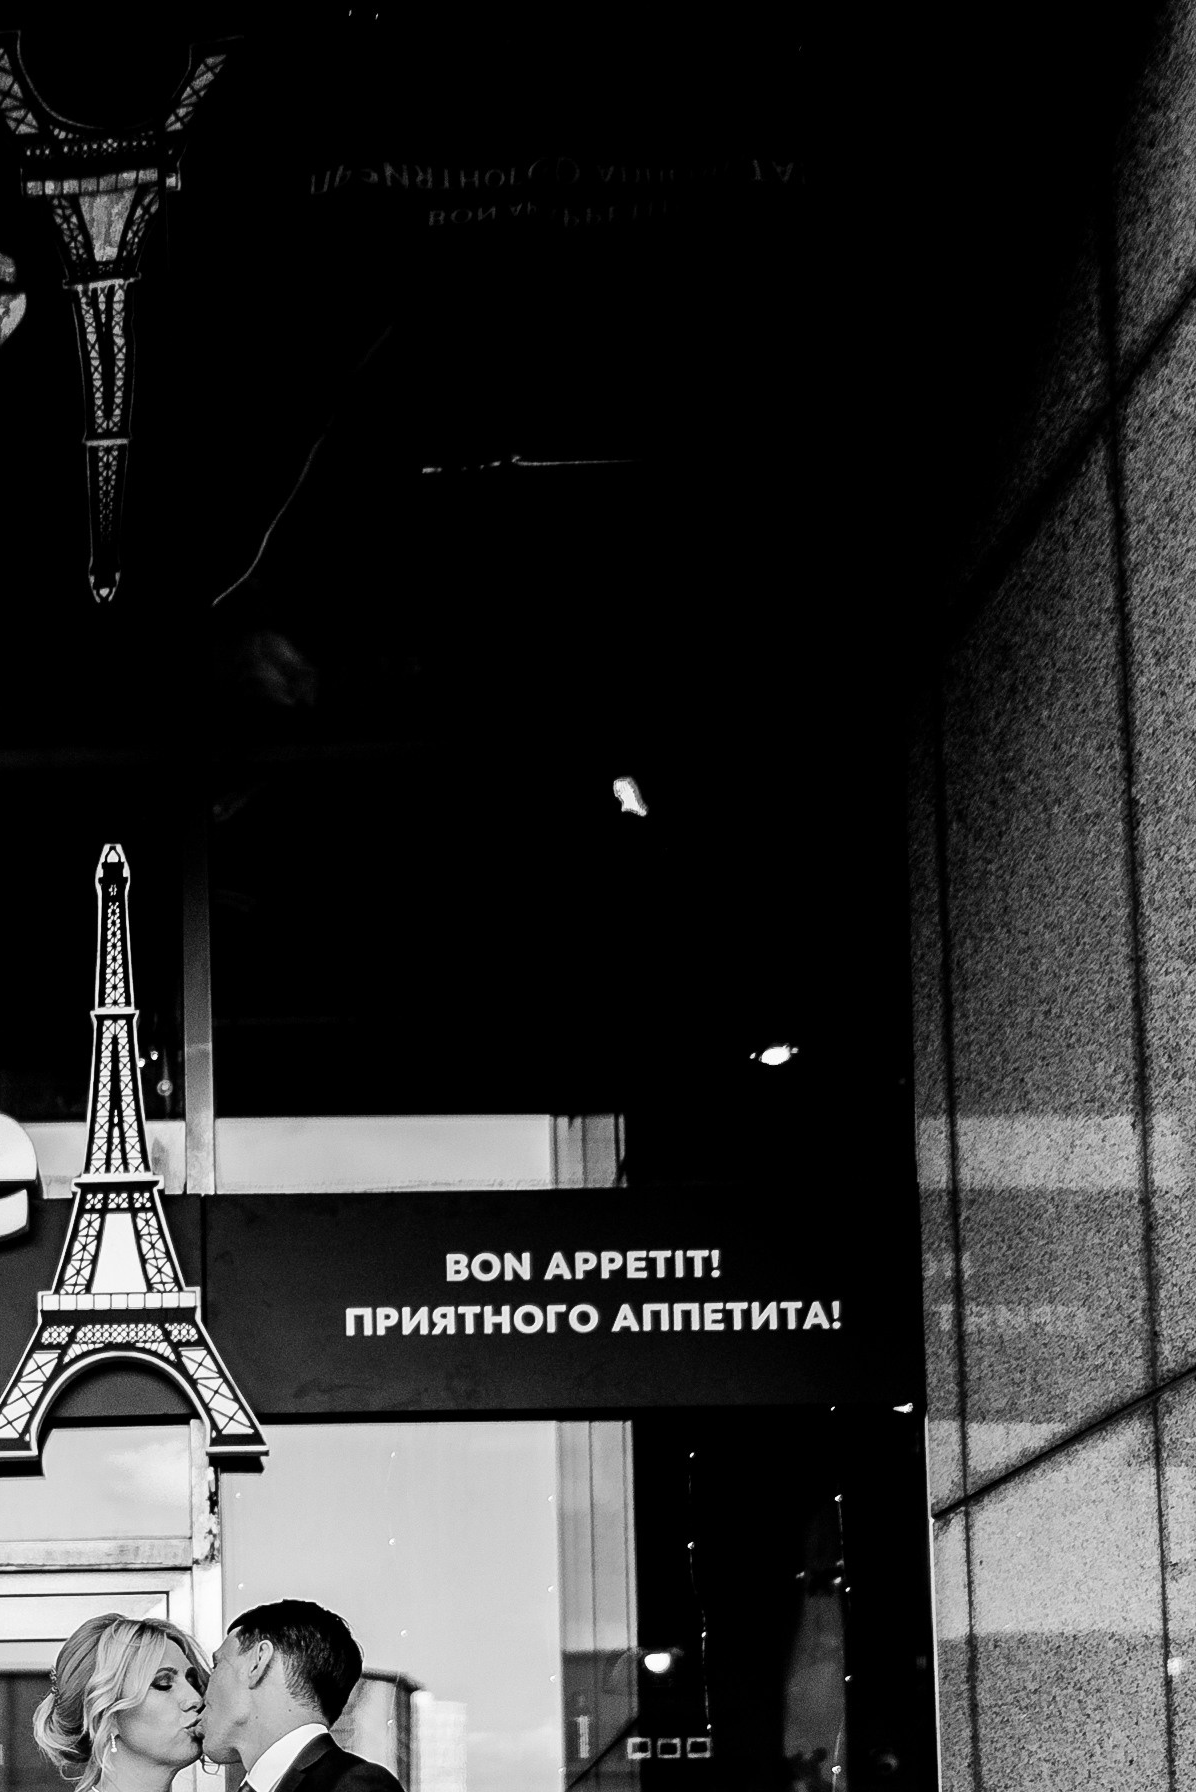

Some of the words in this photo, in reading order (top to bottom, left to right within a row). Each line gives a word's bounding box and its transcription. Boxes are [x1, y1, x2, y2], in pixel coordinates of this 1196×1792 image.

[445, 1252, 531, 1282] BON
[544, 1249, 721, 1280] APPETIT!
[345, 1303, 600, 1337] ПРИЯТНОГО
[611, 1300, 841, 1332] АППЕТИТА!
